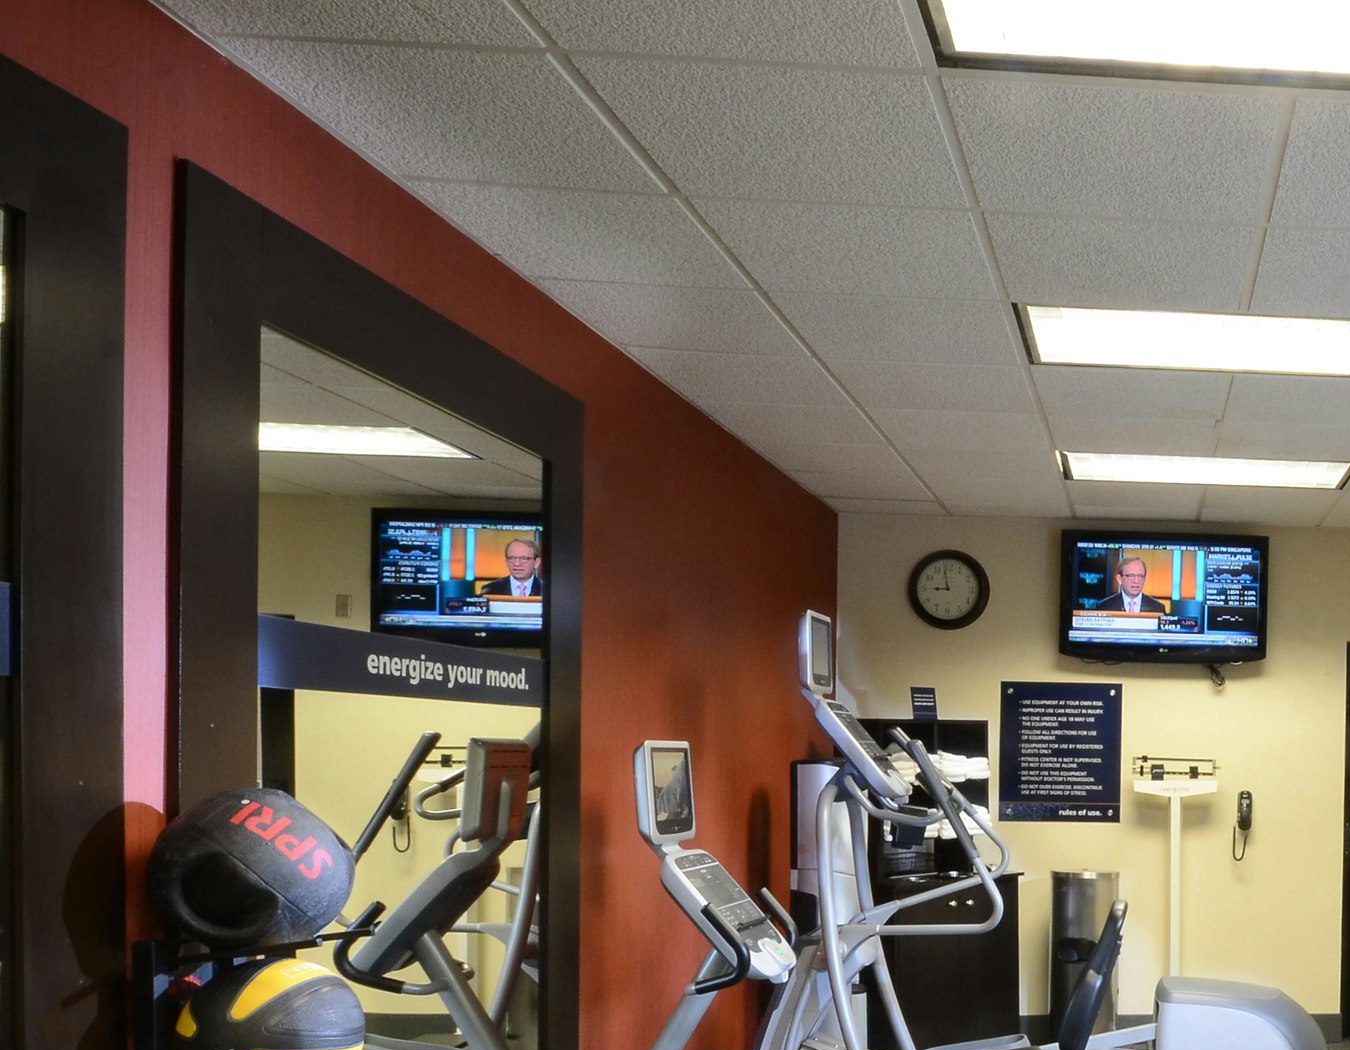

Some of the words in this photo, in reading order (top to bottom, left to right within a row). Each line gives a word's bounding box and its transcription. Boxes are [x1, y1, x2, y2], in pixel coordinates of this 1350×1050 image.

[367, 654, 443, 685] energize
[448, 664, 482, 688] your
[486, 668, 529, 690] mood.
[230, 801, 334, 880] SPRI
